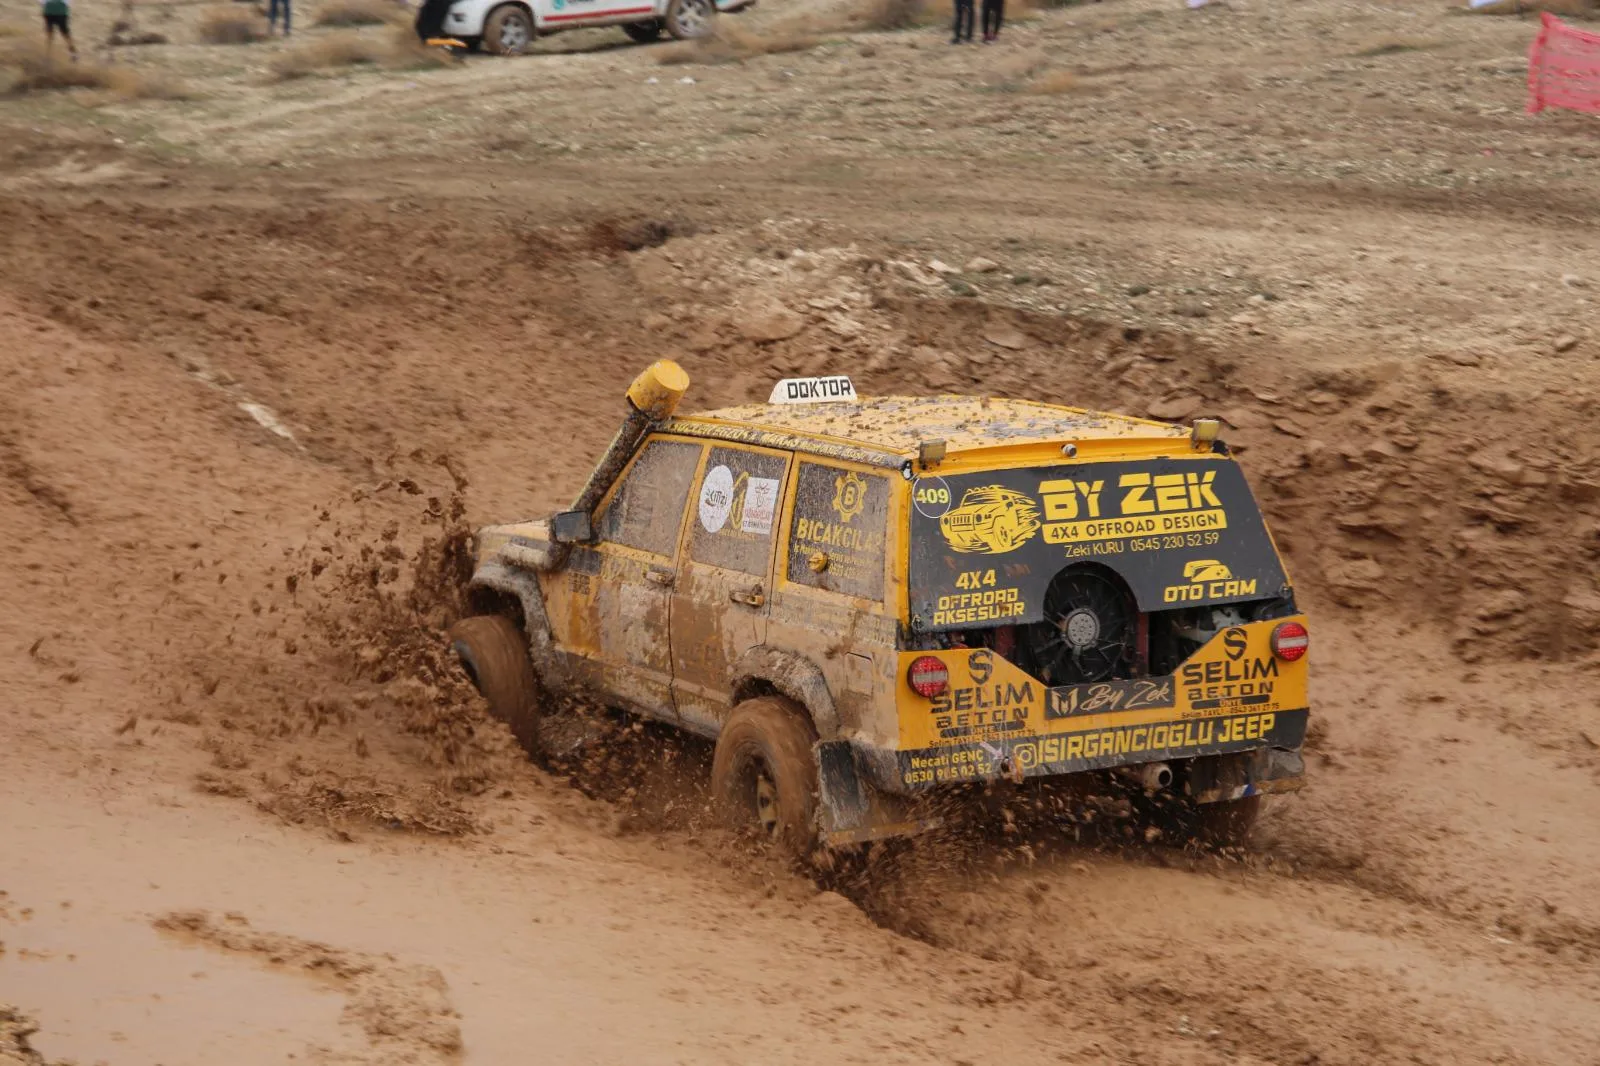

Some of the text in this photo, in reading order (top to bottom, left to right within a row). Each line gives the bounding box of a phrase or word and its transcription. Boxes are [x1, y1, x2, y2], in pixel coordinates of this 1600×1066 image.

[787, 378, 851, 400] DOKTOR
[915, 487, 949, 504] 409
[1038, 470, 1223, 521] BY ZEK
[1051, 512, 1219, 541] 4X4 OFFROAD DESIGN
[1064, 531, 1220, 559] Zeki KURU 0545 230 52 59
[955, 569, 997, 590] 4X4
[1163, 579, 1256, 604] OTO CAM
[938, 587, 1019, 611] OFFROAD
[932, 601, 1025, 625] AKSESUAR
[1080, 684, 1125, 711] By
[1124, 680, 1171, 709] Zek
[1188, 682, 1273, 702] BETON
[936, 707, 1029, 729] BETON
[1038, 713, 1275, 765] ISIRGANCIOGLU JEEP
[904, 770, 934, 784] 0530
[936, 766, 958, 779] 95
[977, 762, 993, 774] 52
[911, 754, 949, 769] Necati
